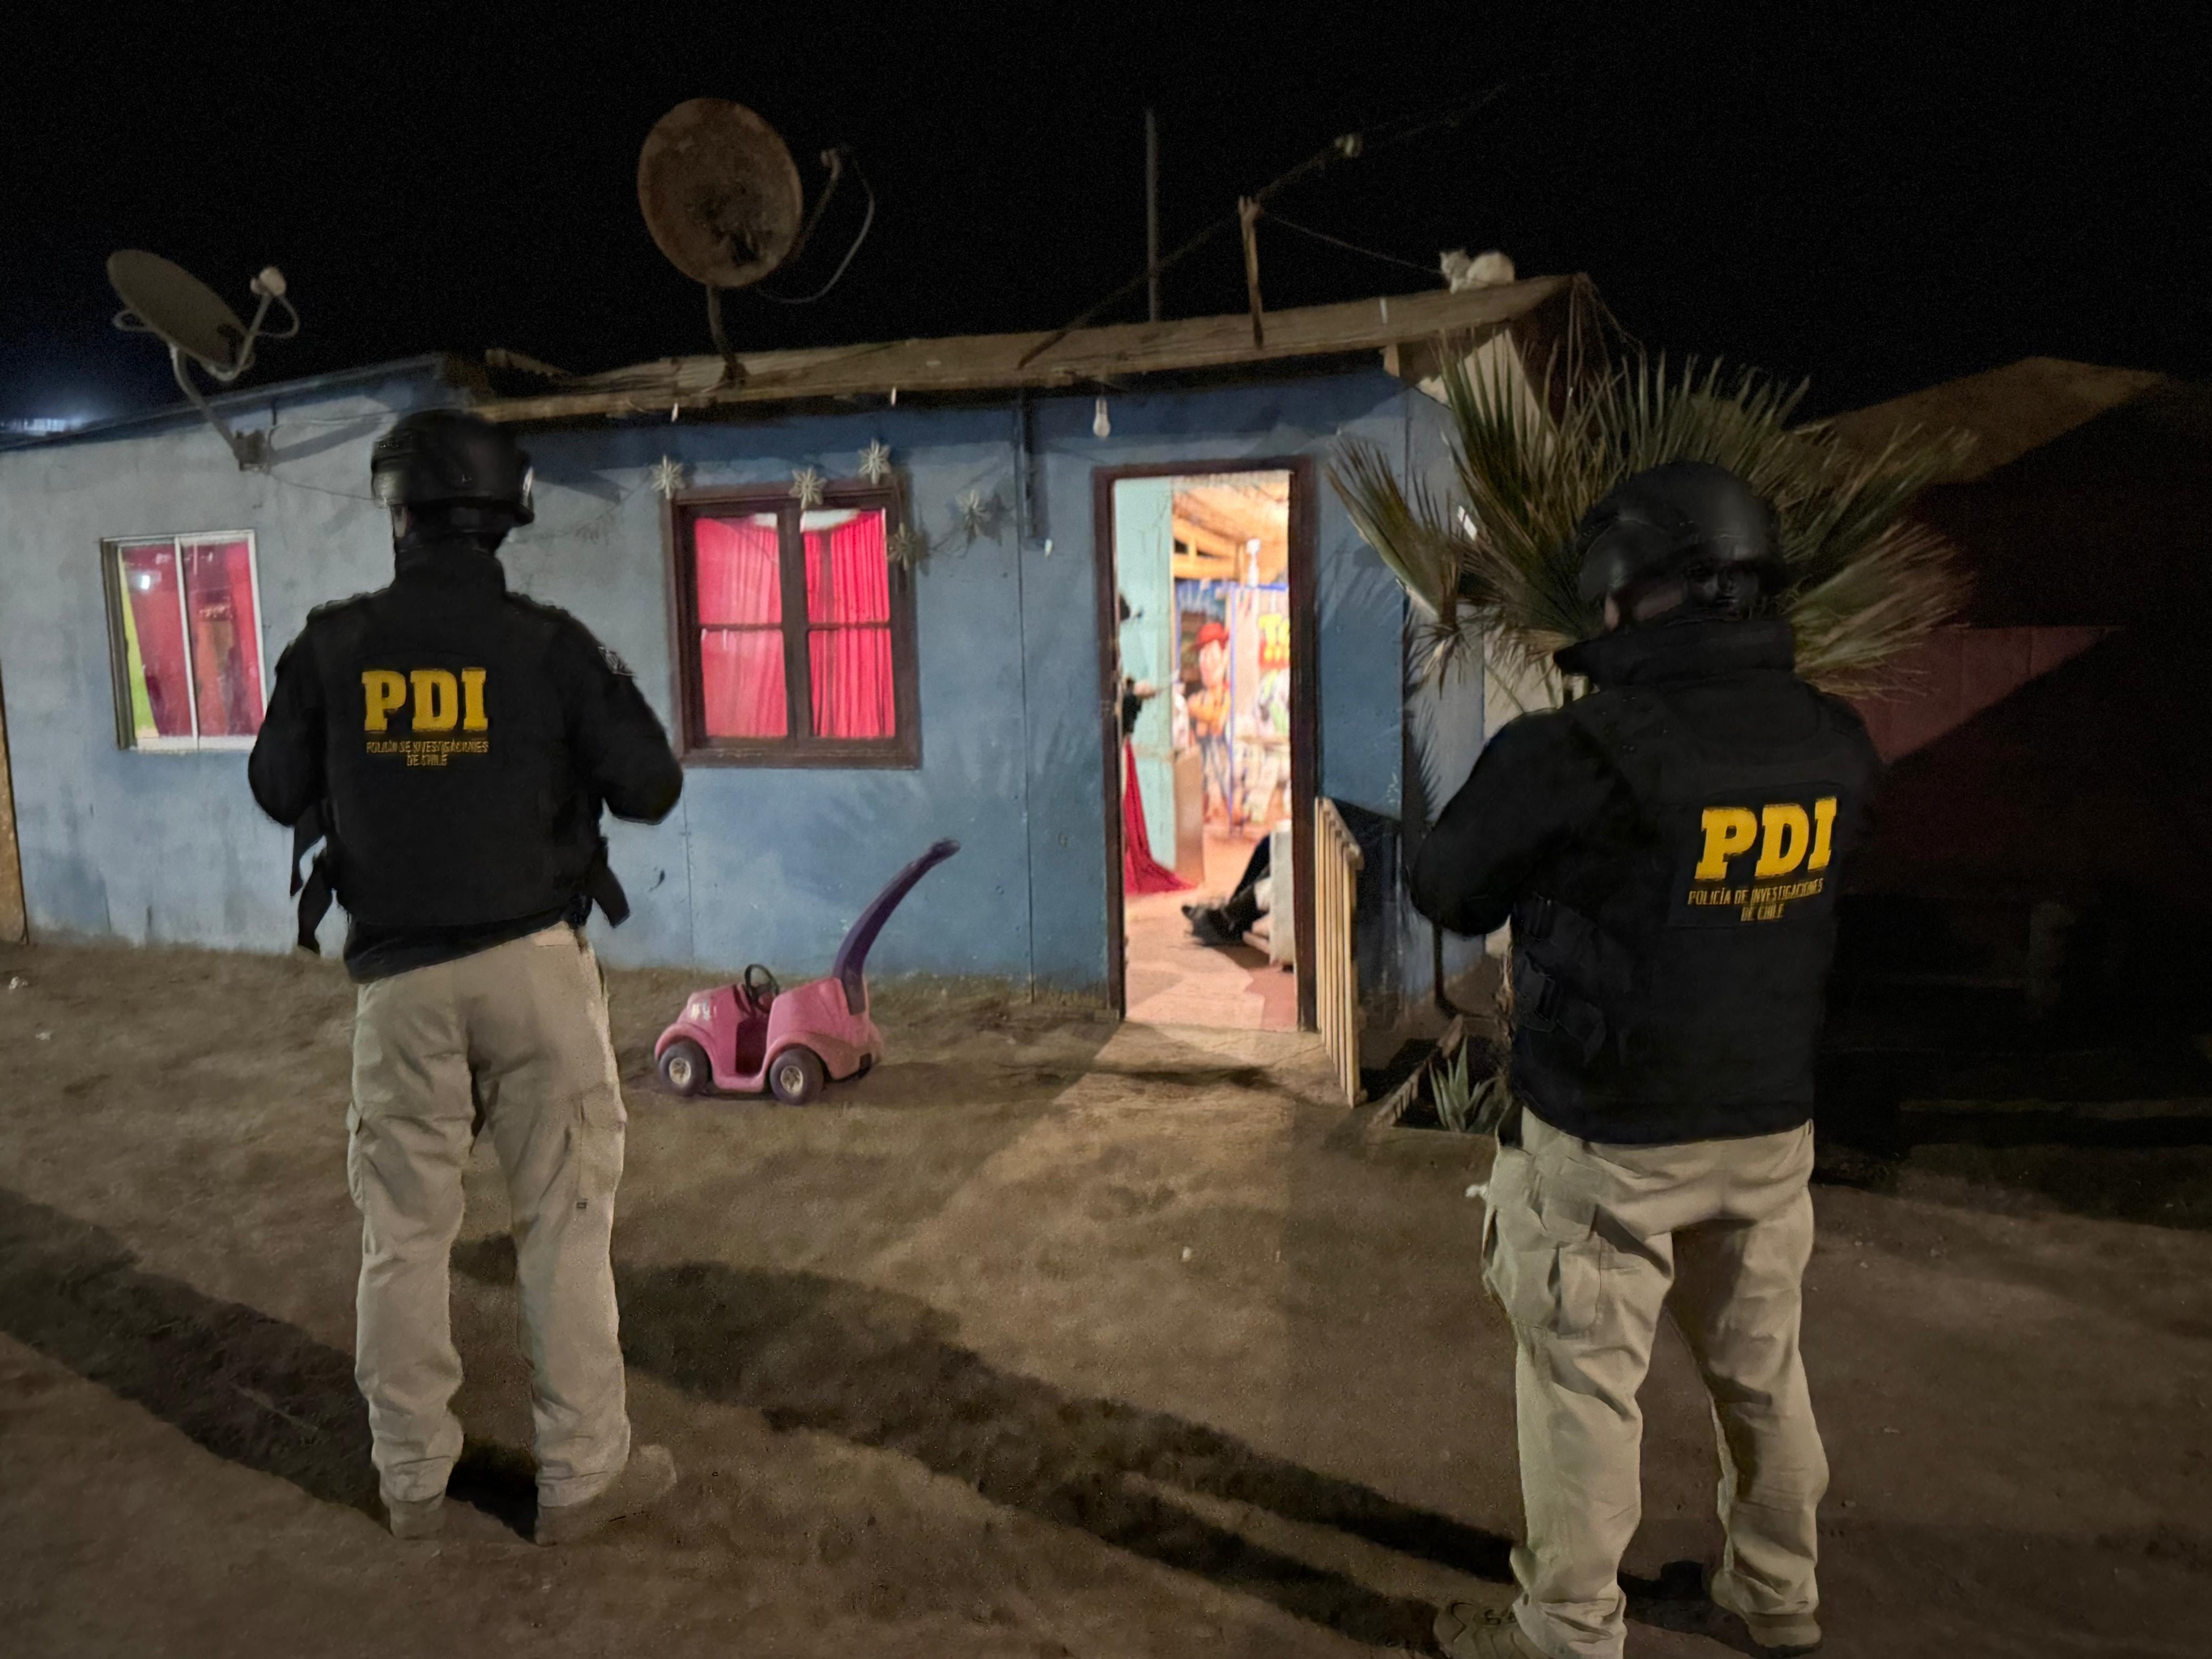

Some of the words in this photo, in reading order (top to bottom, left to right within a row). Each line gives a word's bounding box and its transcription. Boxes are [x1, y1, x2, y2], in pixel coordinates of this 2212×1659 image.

[362, 667, 489, 732] PDI
[1694, 796, 1837, 881] PDI
[1687, 887, 1731, 905] POLICÍA
[1734, 890, 1749, 905] DE
[1740, 907, 1754, 921] DE
